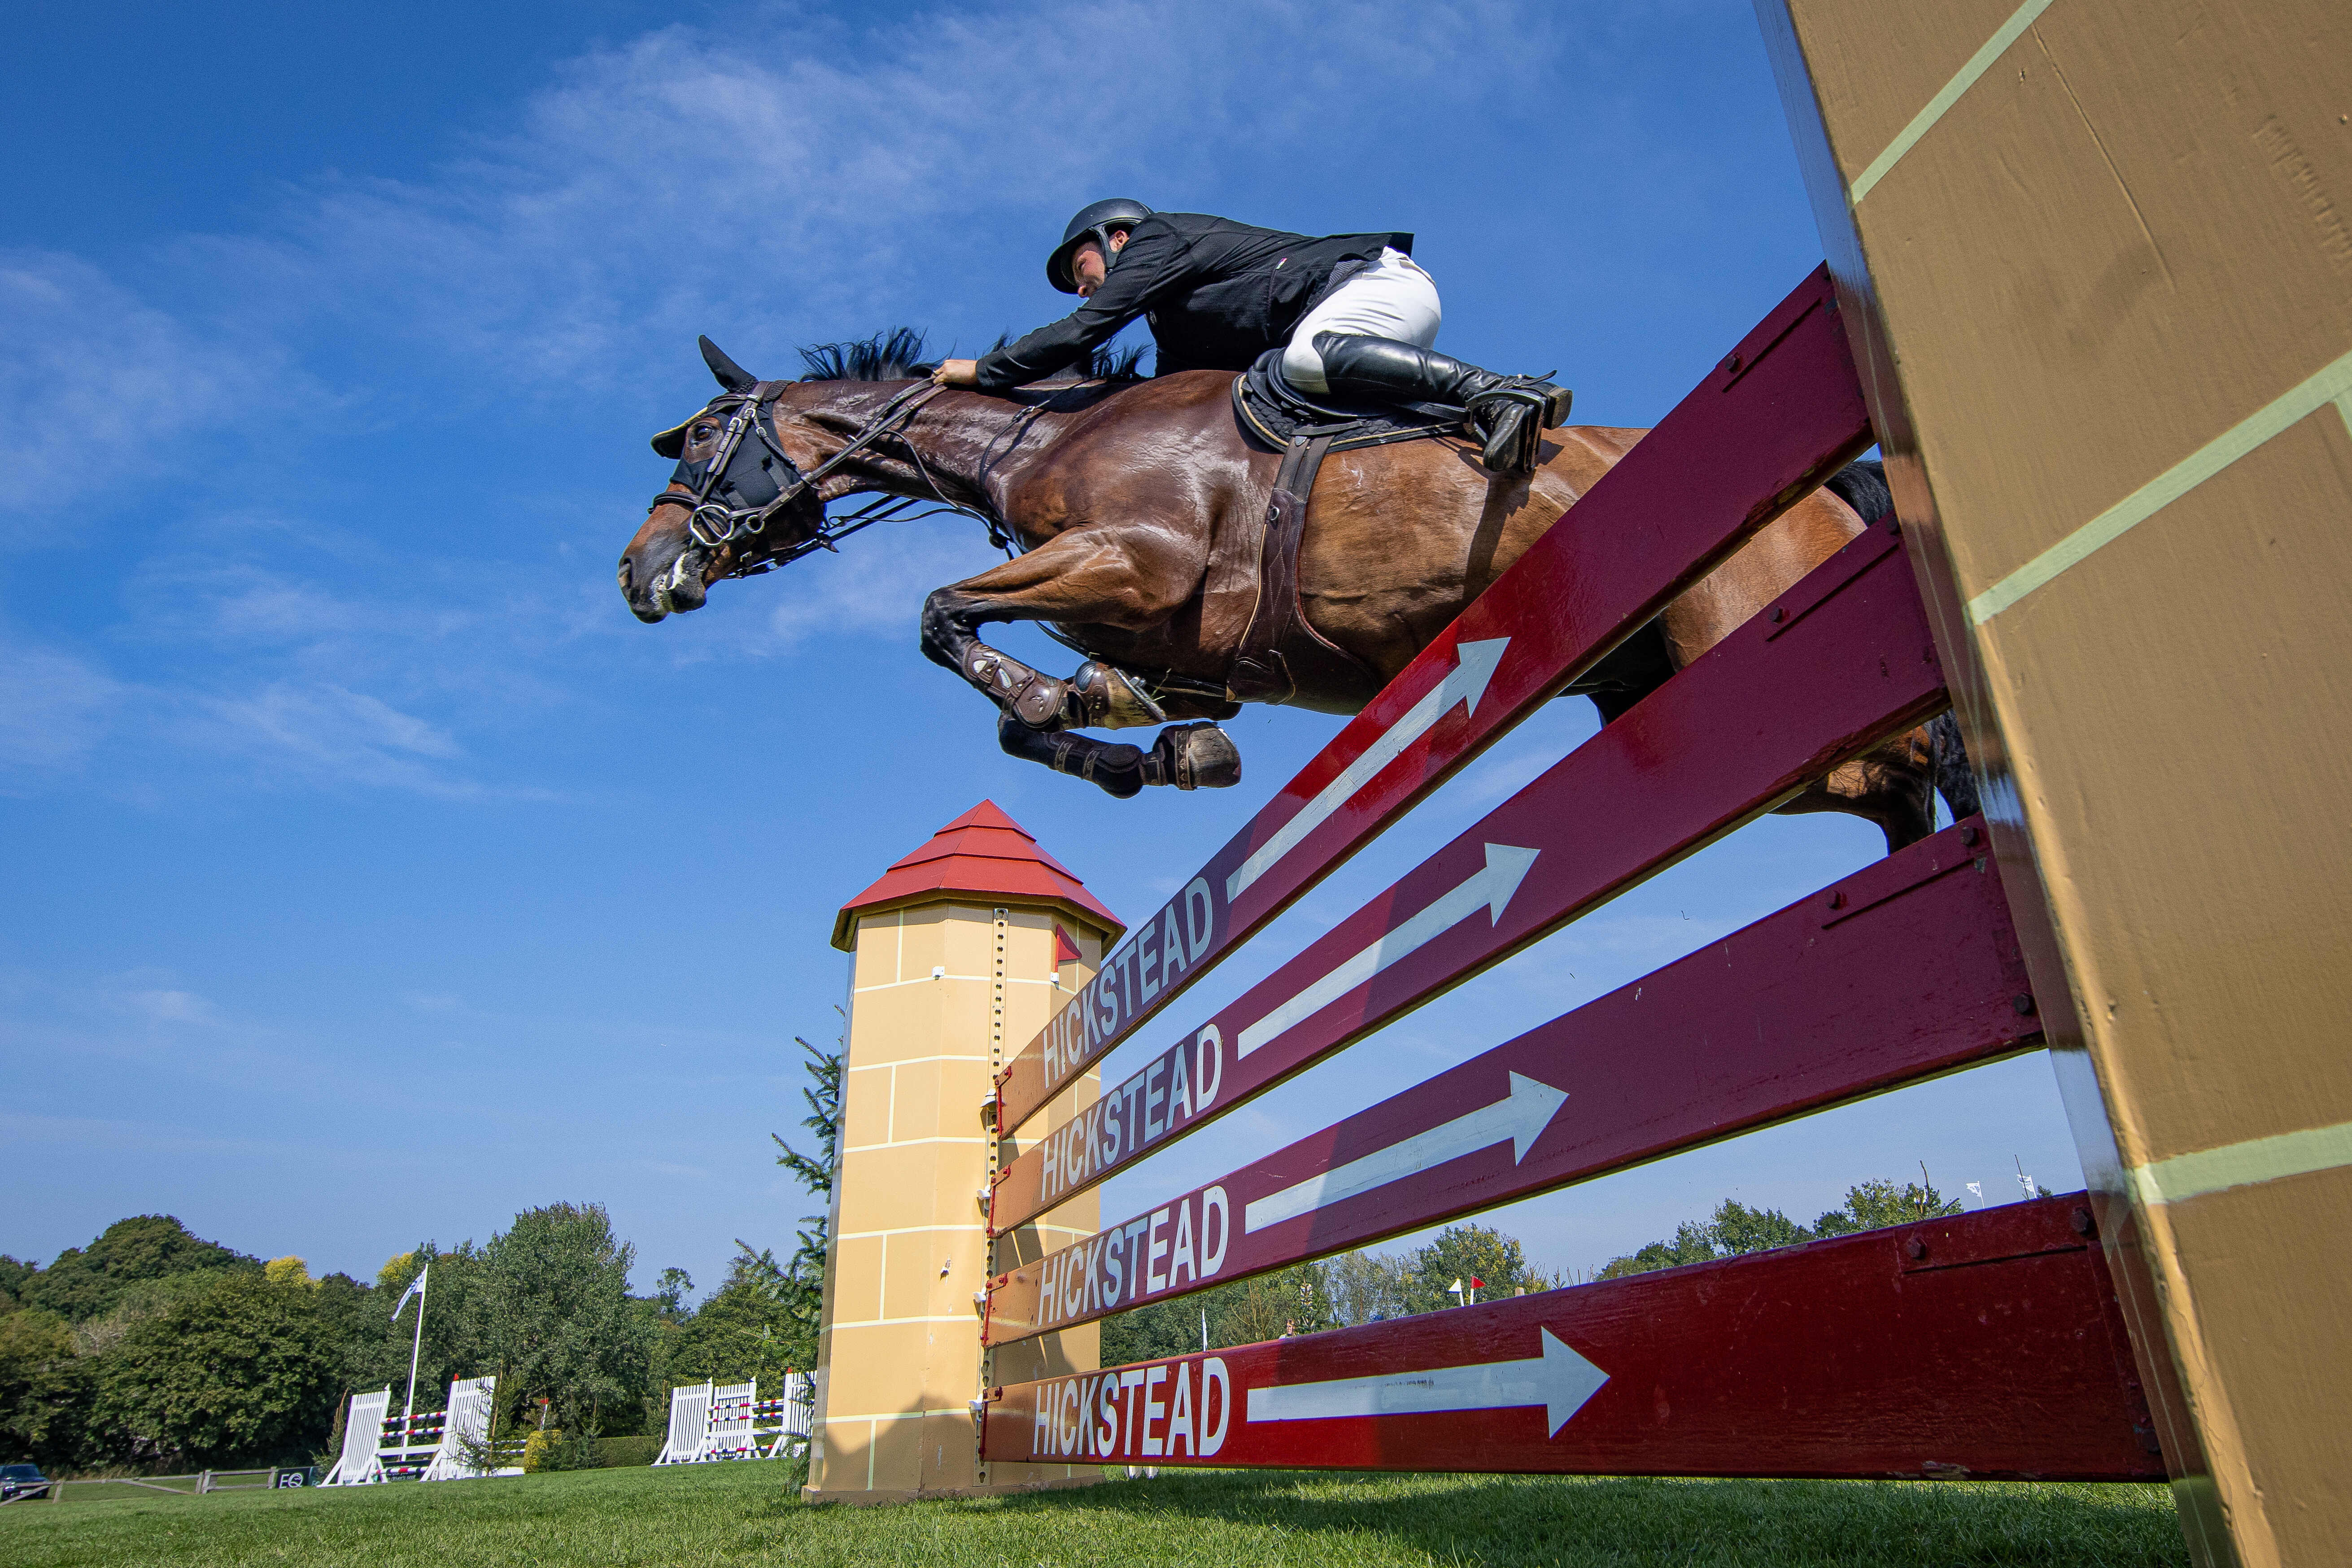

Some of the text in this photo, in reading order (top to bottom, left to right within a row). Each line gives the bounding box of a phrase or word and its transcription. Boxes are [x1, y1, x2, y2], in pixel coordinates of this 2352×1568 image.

[1044, 877, 1212, 1088] HICKSTEAD
[1041, 1024, 1222, 1201] HICKSTEAD
[1038, 1186, 1229, 1326] HICKSTEAD
[1033, 1357, 1230, 1458] HICKSTEAD
[279, 1473, 303, 1489] EQ
